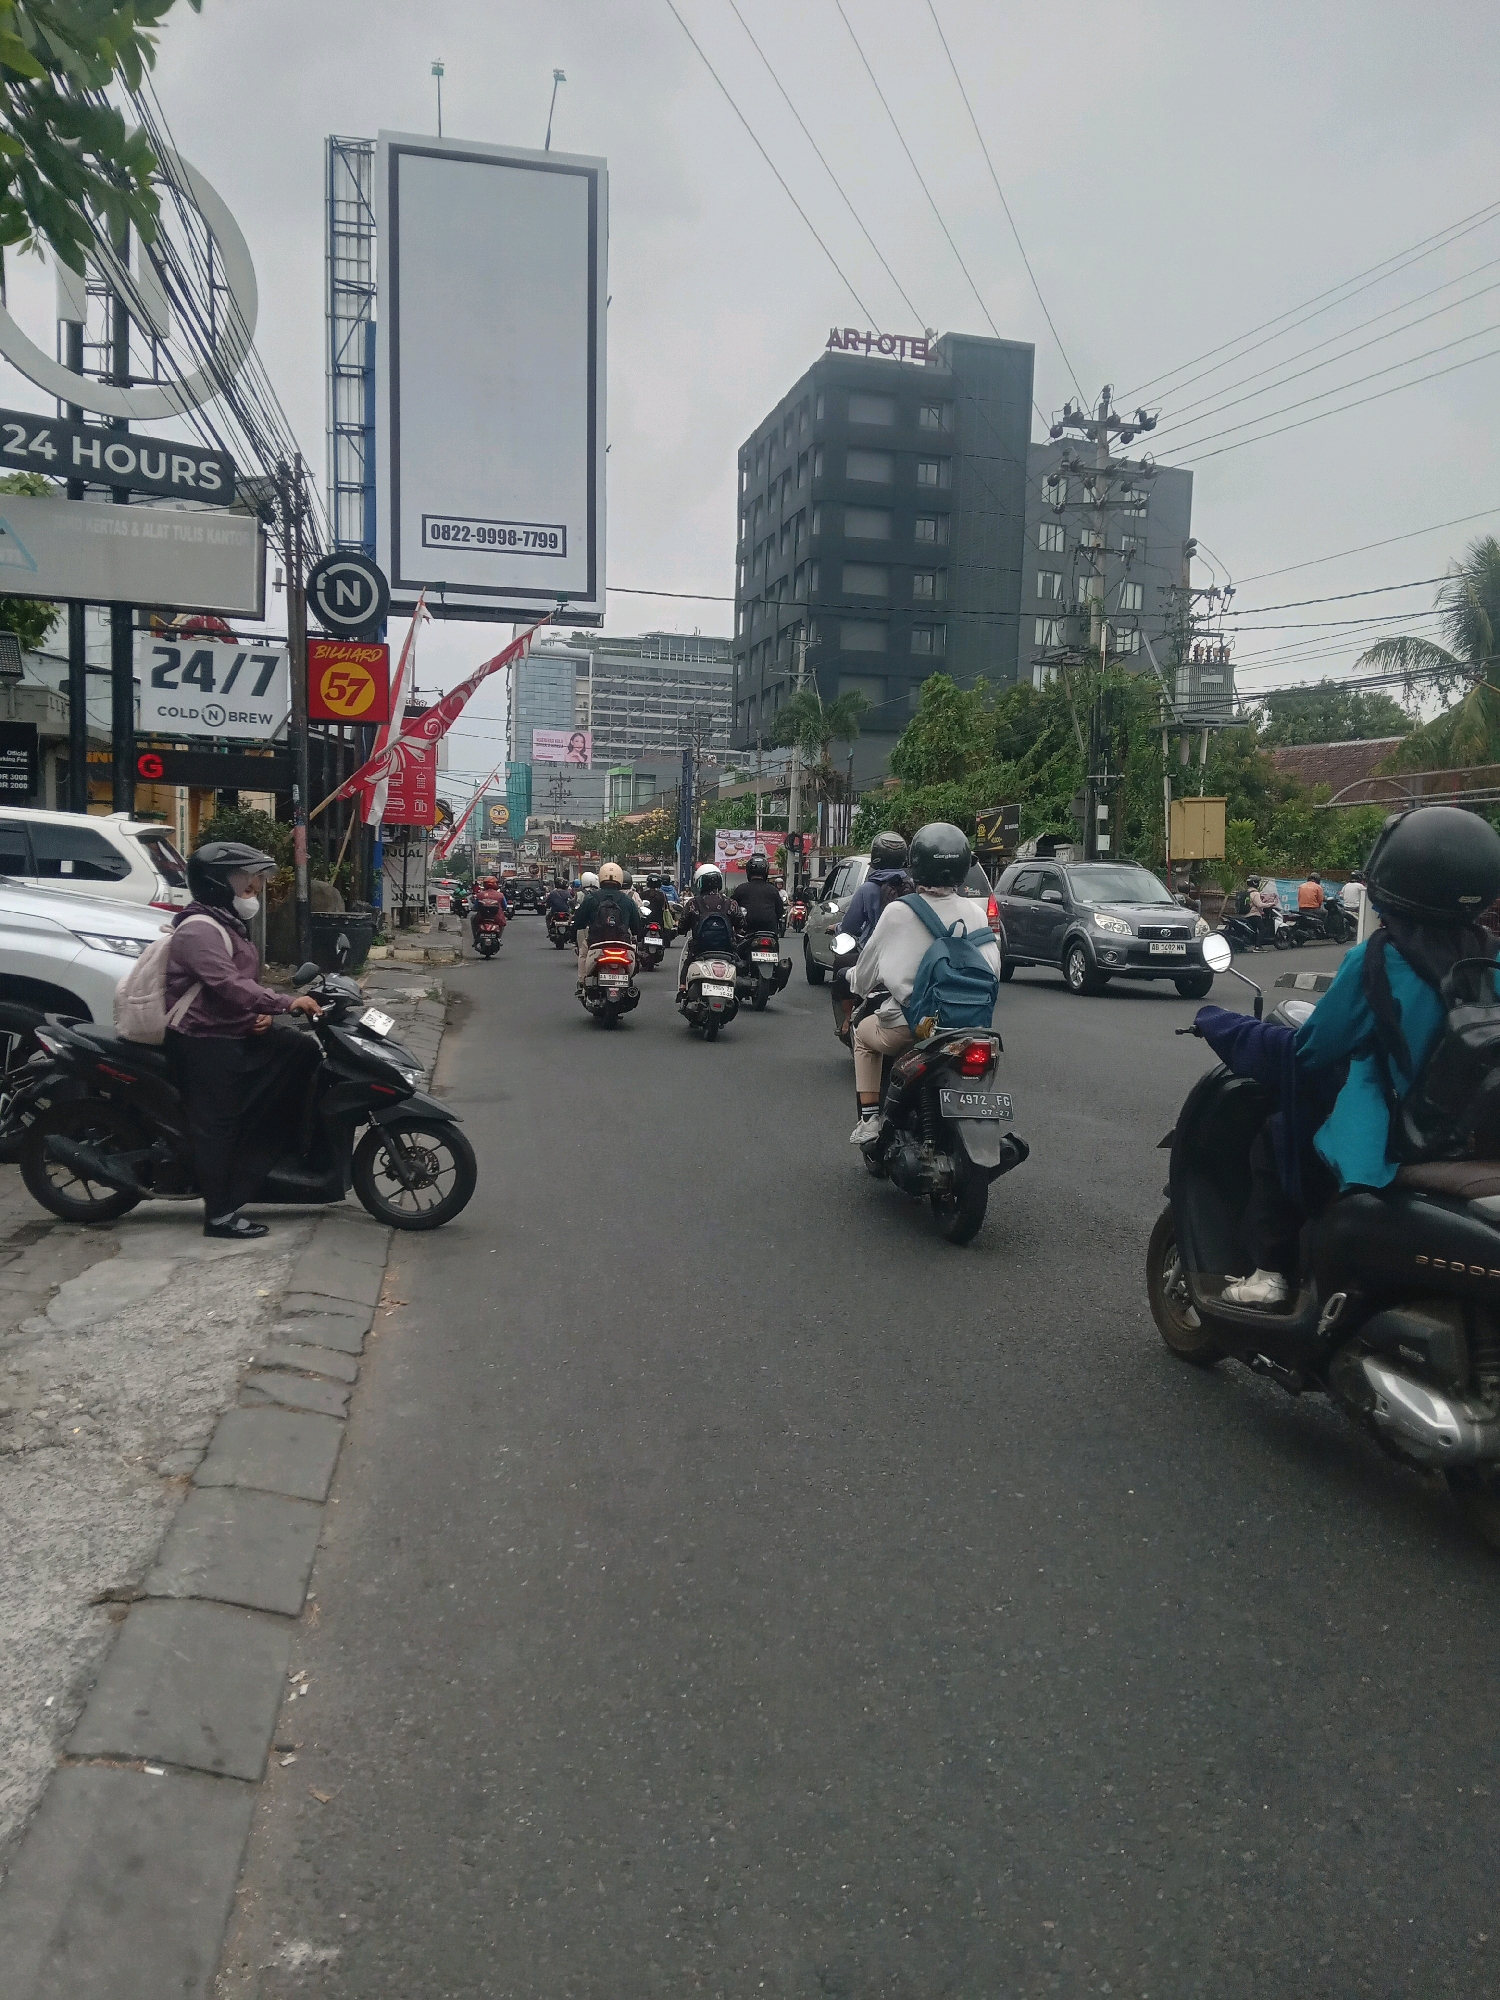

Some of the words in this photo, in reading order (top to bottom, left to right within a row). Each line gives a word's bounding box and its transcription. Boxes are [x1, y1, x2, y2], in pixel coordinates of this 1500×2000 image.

[2, 423, 57, 460] 24
[73, 436, 222, 490] HOURS
[86, 517, 128, 536] KERTAS
[131, 521, 139, 537] &
[142, 522, 169, 540] ALAT
[172, 524, 204, 543] TULIS
[206, 529, 250, 546] KANTOR
[430, 523, 559, 549] 0822-9998-7799
[336, 579, 361, 607] N
[313, 645, 384, 663] BILLIARD
[151, 646, 280, 697] 24/7
[324, 671, 370, 706] 57
[157, 706, 199, 719] COLD
[228, 712, 273, 725] BREW
[10, 773, 28, 781] 3000
[138, 753, 163, 778] G
[943, 1092, 951, 1103] K
[959, 1093, 988, 1106] 4972
[996, 1095, 1011, 1107] FG
